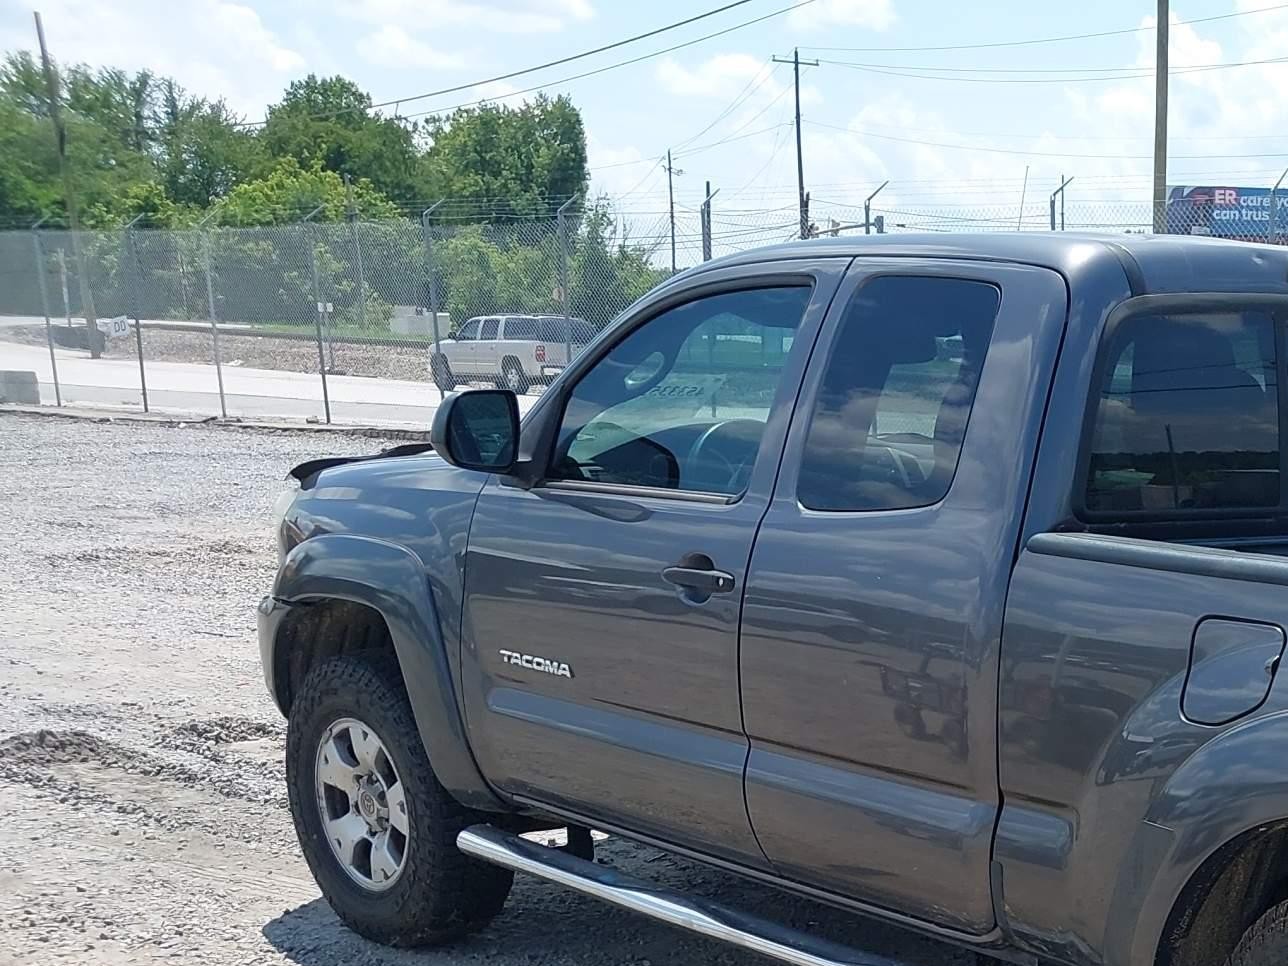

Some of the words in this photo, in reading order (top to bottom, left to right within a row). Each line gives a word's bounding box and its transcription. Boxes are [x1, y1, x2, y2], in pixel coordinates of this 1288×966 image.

[1214, 189, 1236, 204] ER
[1240, 195, 1270, 207] care
[1213, 208, 1239, 220] can
[1241, 209, 1280, 221] trus
[498, 649, 572, 678] TACOMA
